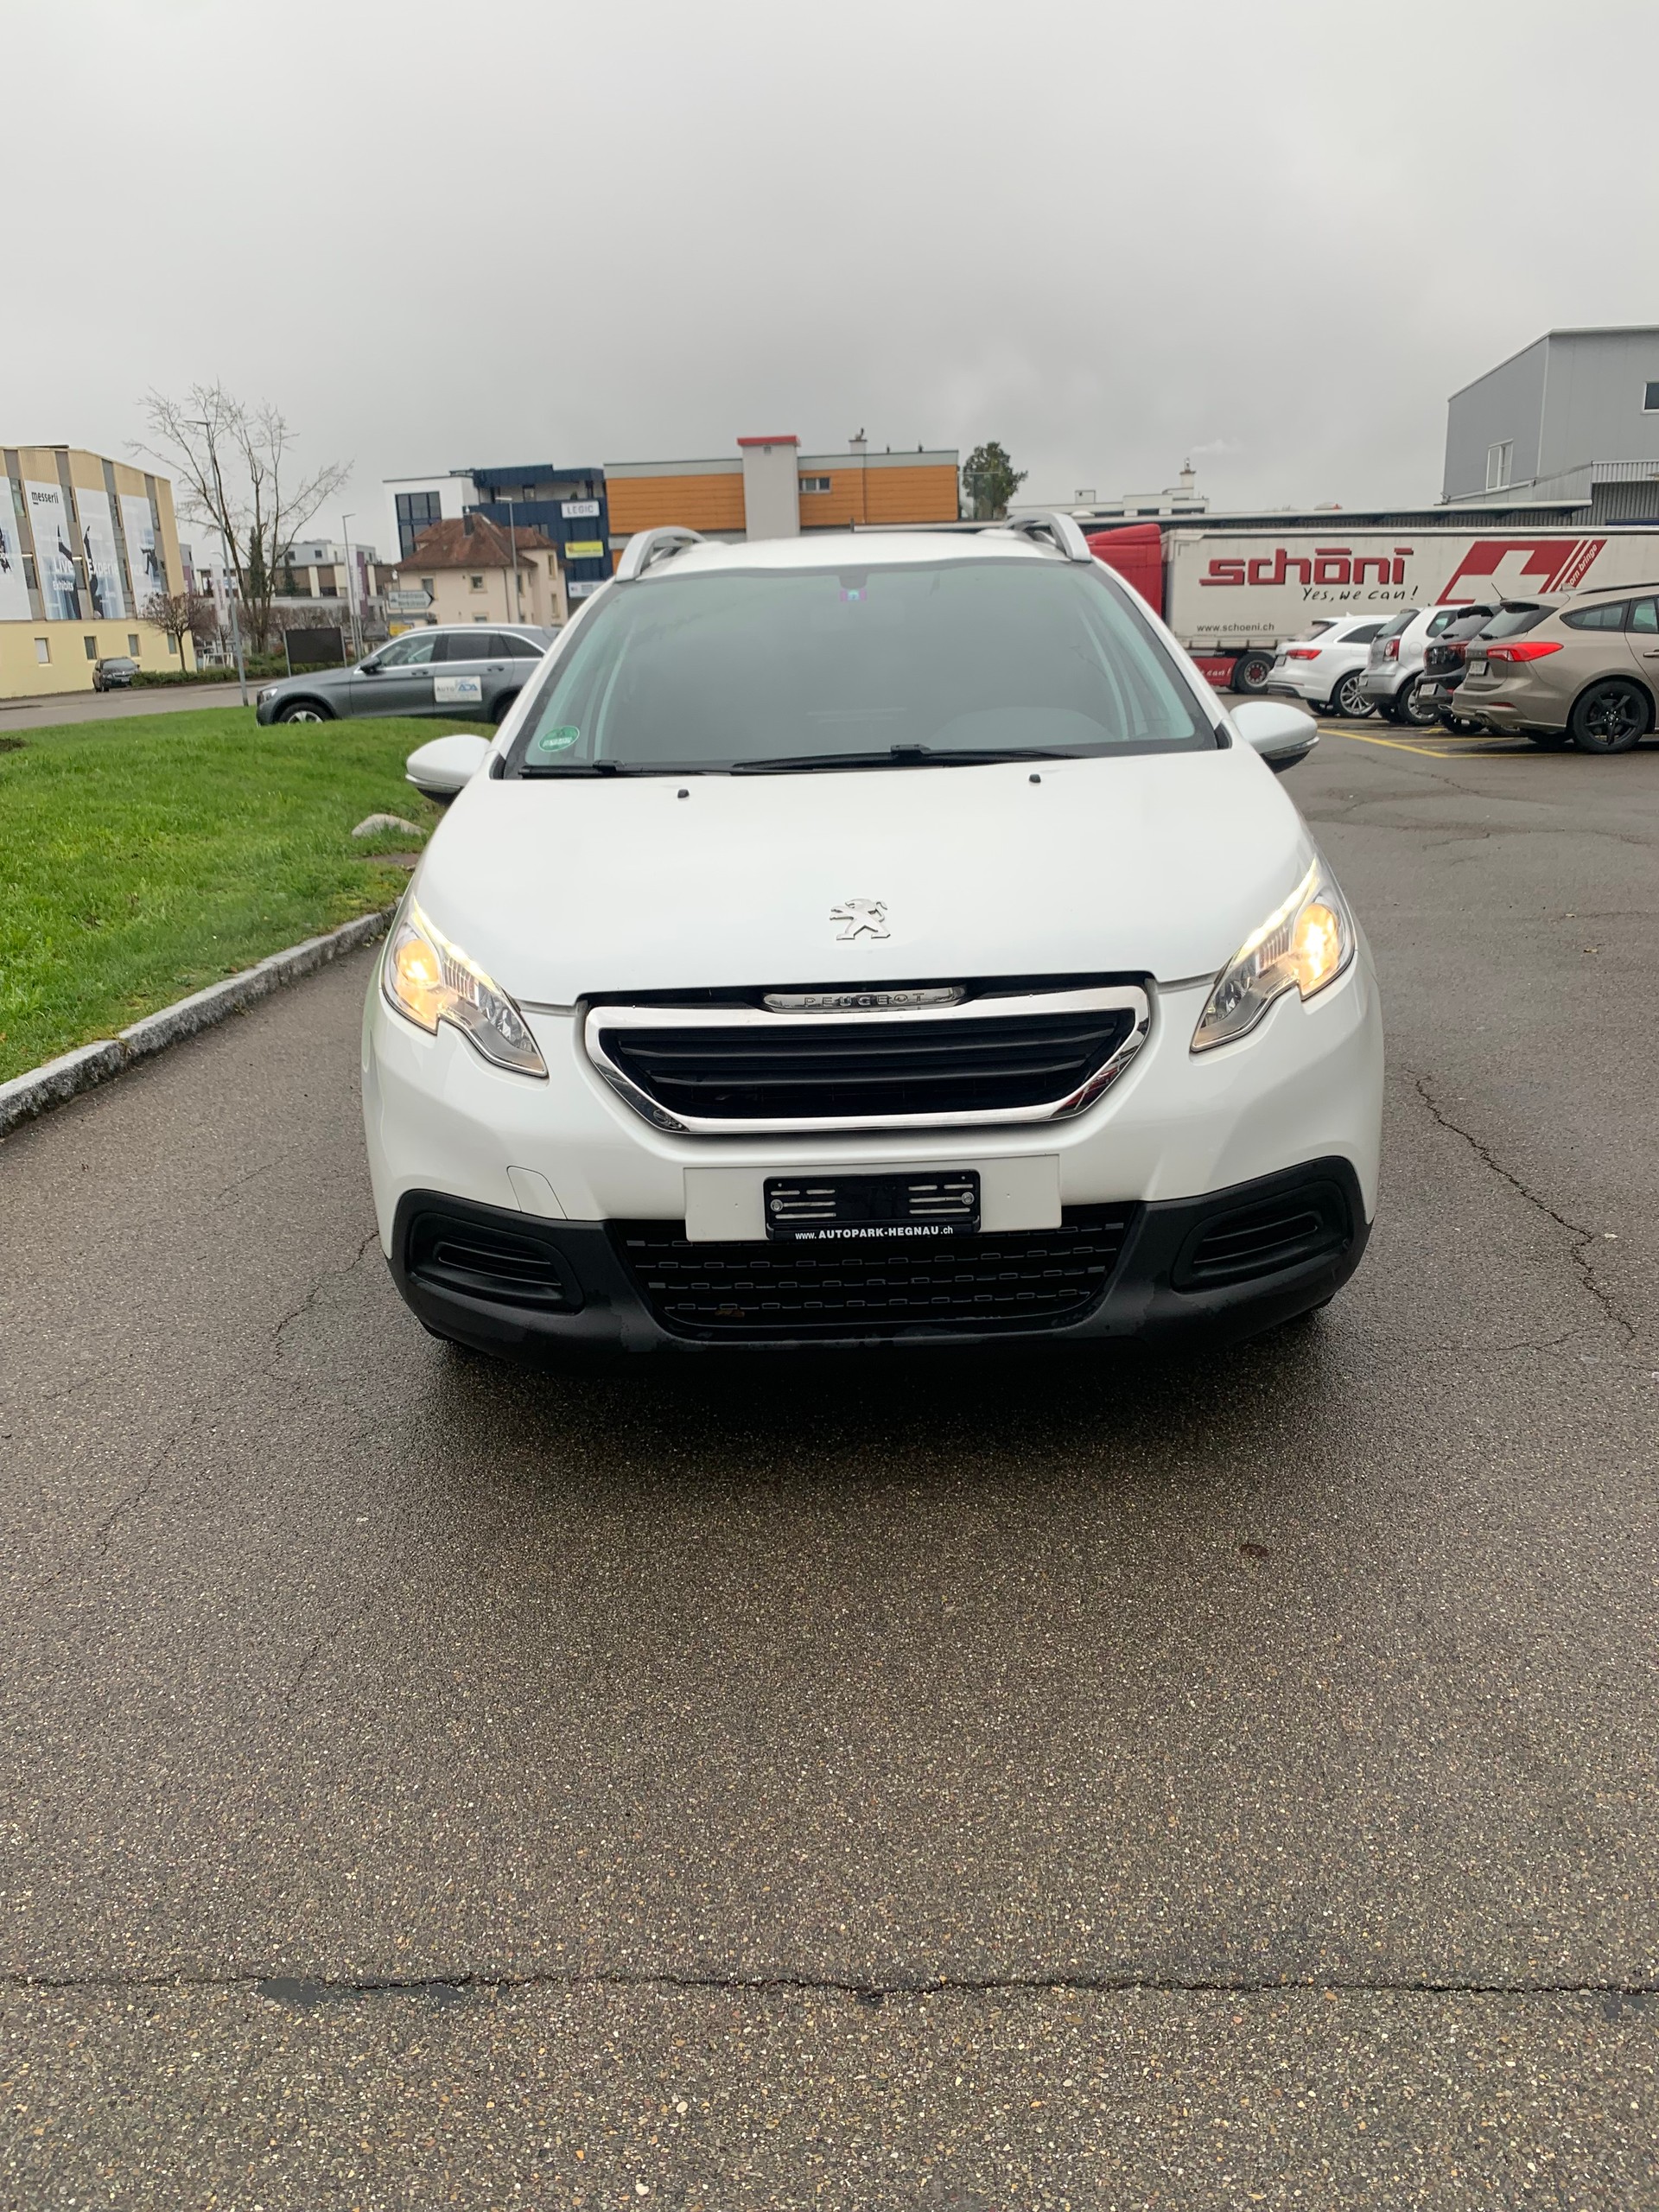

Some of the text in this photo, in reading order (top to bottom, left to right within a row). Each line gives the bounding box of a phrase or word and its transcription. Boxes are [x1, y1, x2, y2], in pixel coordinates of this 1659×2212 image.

[31, 491, 59, 504] messerli
[567, 505, 594, 515] LEGIC
[1302, 587, 1334, 601] Yes,
[1339, 589, 1362, 601] we
[1196, 622, 1274, 633] www.schoeni.ch
[804, 992, 925, 1007] PEUGEOT
